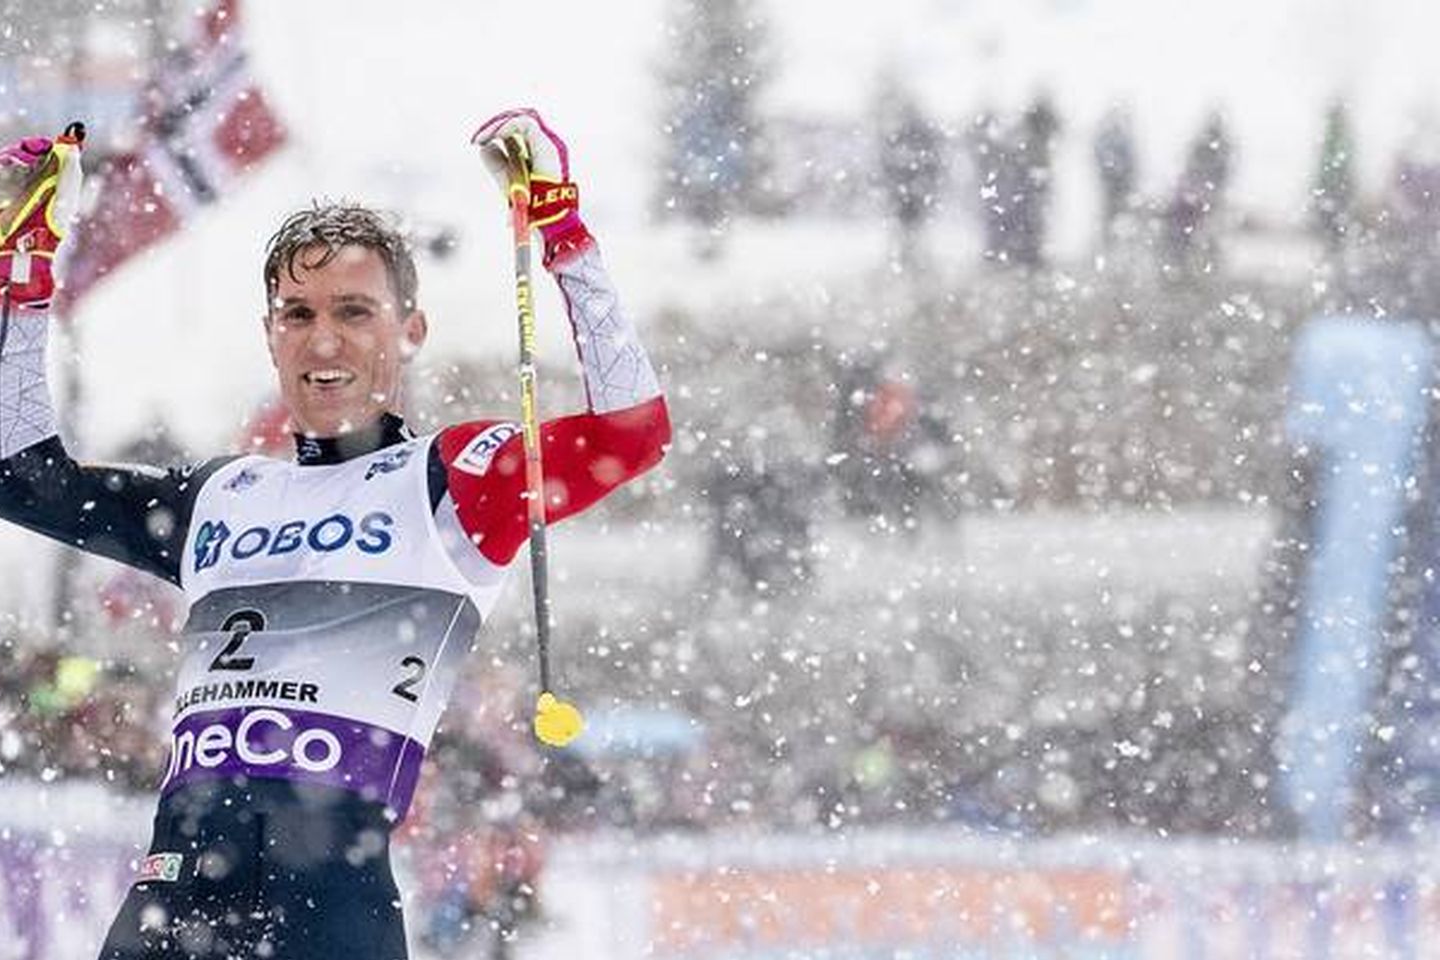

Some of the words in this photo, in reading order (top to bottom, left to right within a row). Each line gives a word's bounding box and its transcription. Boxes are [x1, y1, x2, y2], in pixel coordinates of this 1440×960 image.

[231, 511, 395, 561] OBOS
[209, 610, 265, 672] 2
[392, 655, 427, 702] 2
